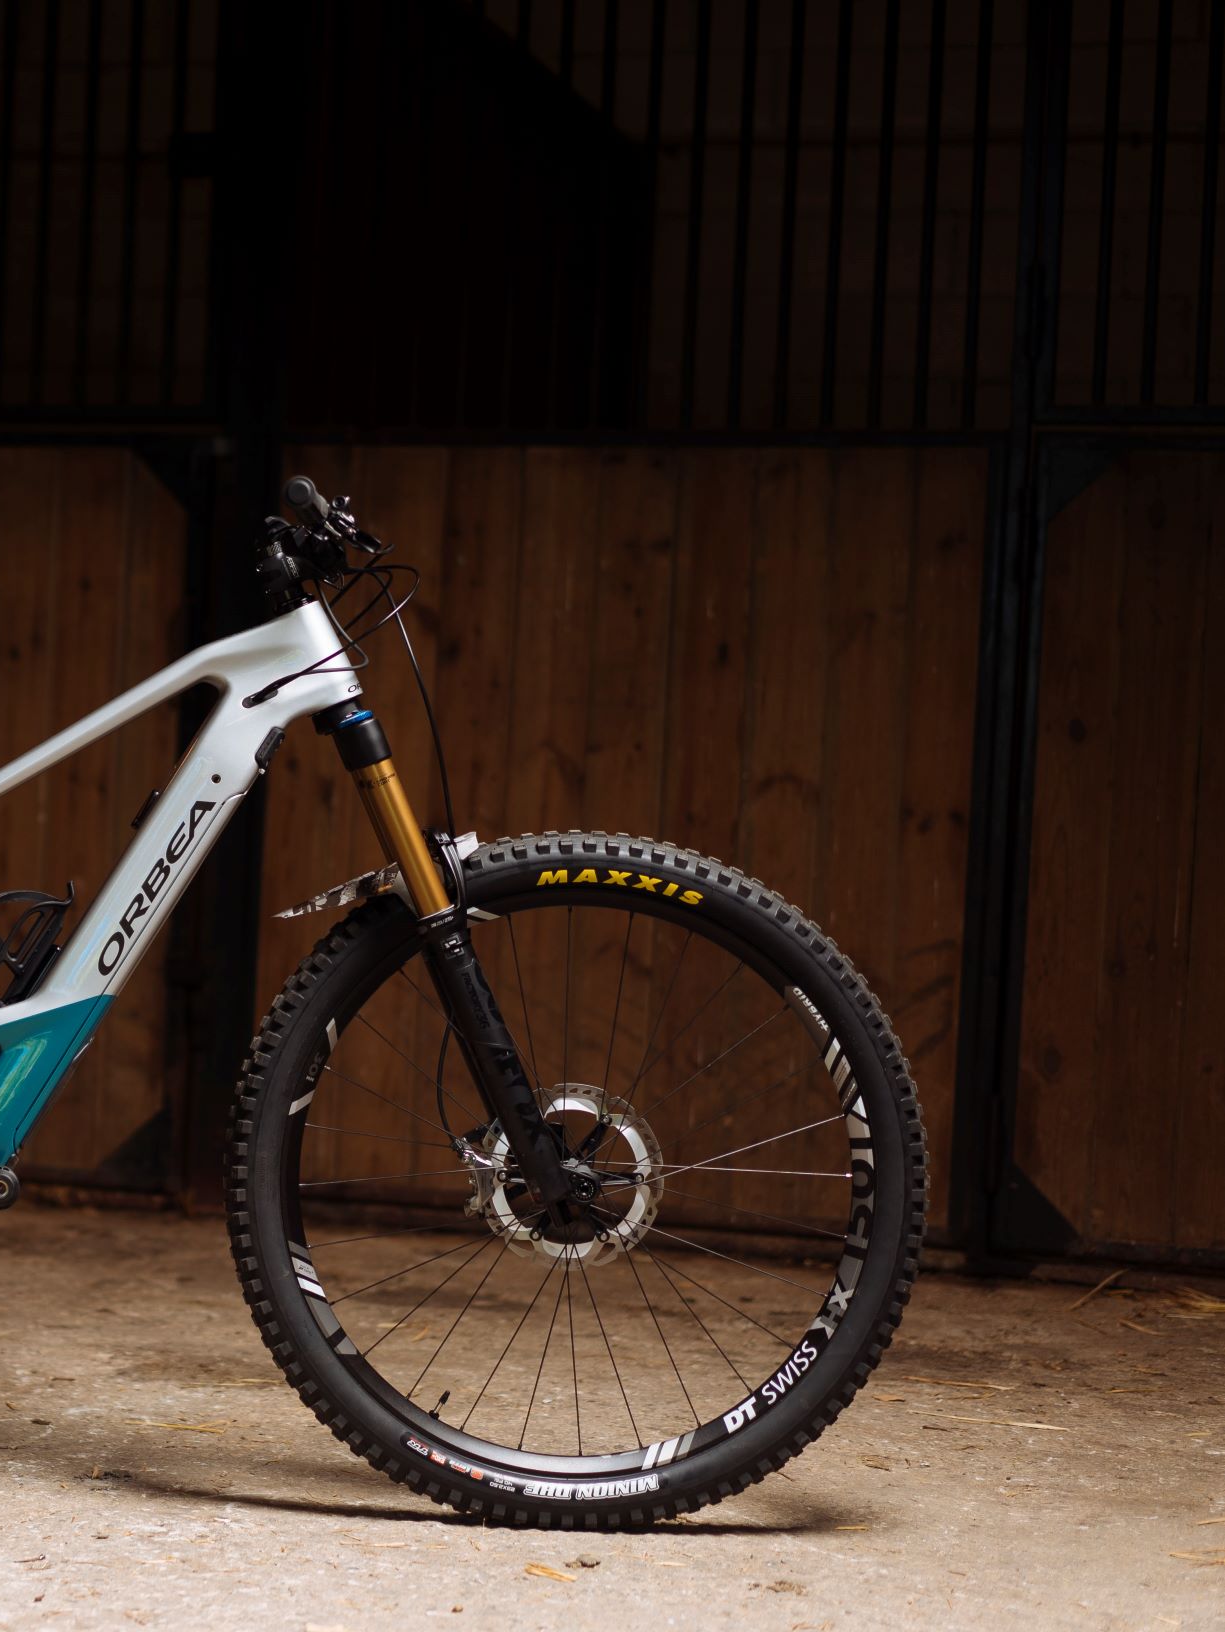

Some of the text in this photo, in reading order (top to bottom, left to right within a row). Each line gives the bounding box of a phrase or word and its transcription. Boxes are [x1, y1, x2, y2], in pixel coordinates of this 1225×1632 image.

[98, 801, 216, 976] ORBEA
[537, 868, 704, 905] MAXXIS
[792, 986, 830, 1032] HYBRID
[722, 1395, 756, 1434] DT
[761, 1340, 818, 1405] SWISS
[523, 1474, 660, 1500] MINION DHF
